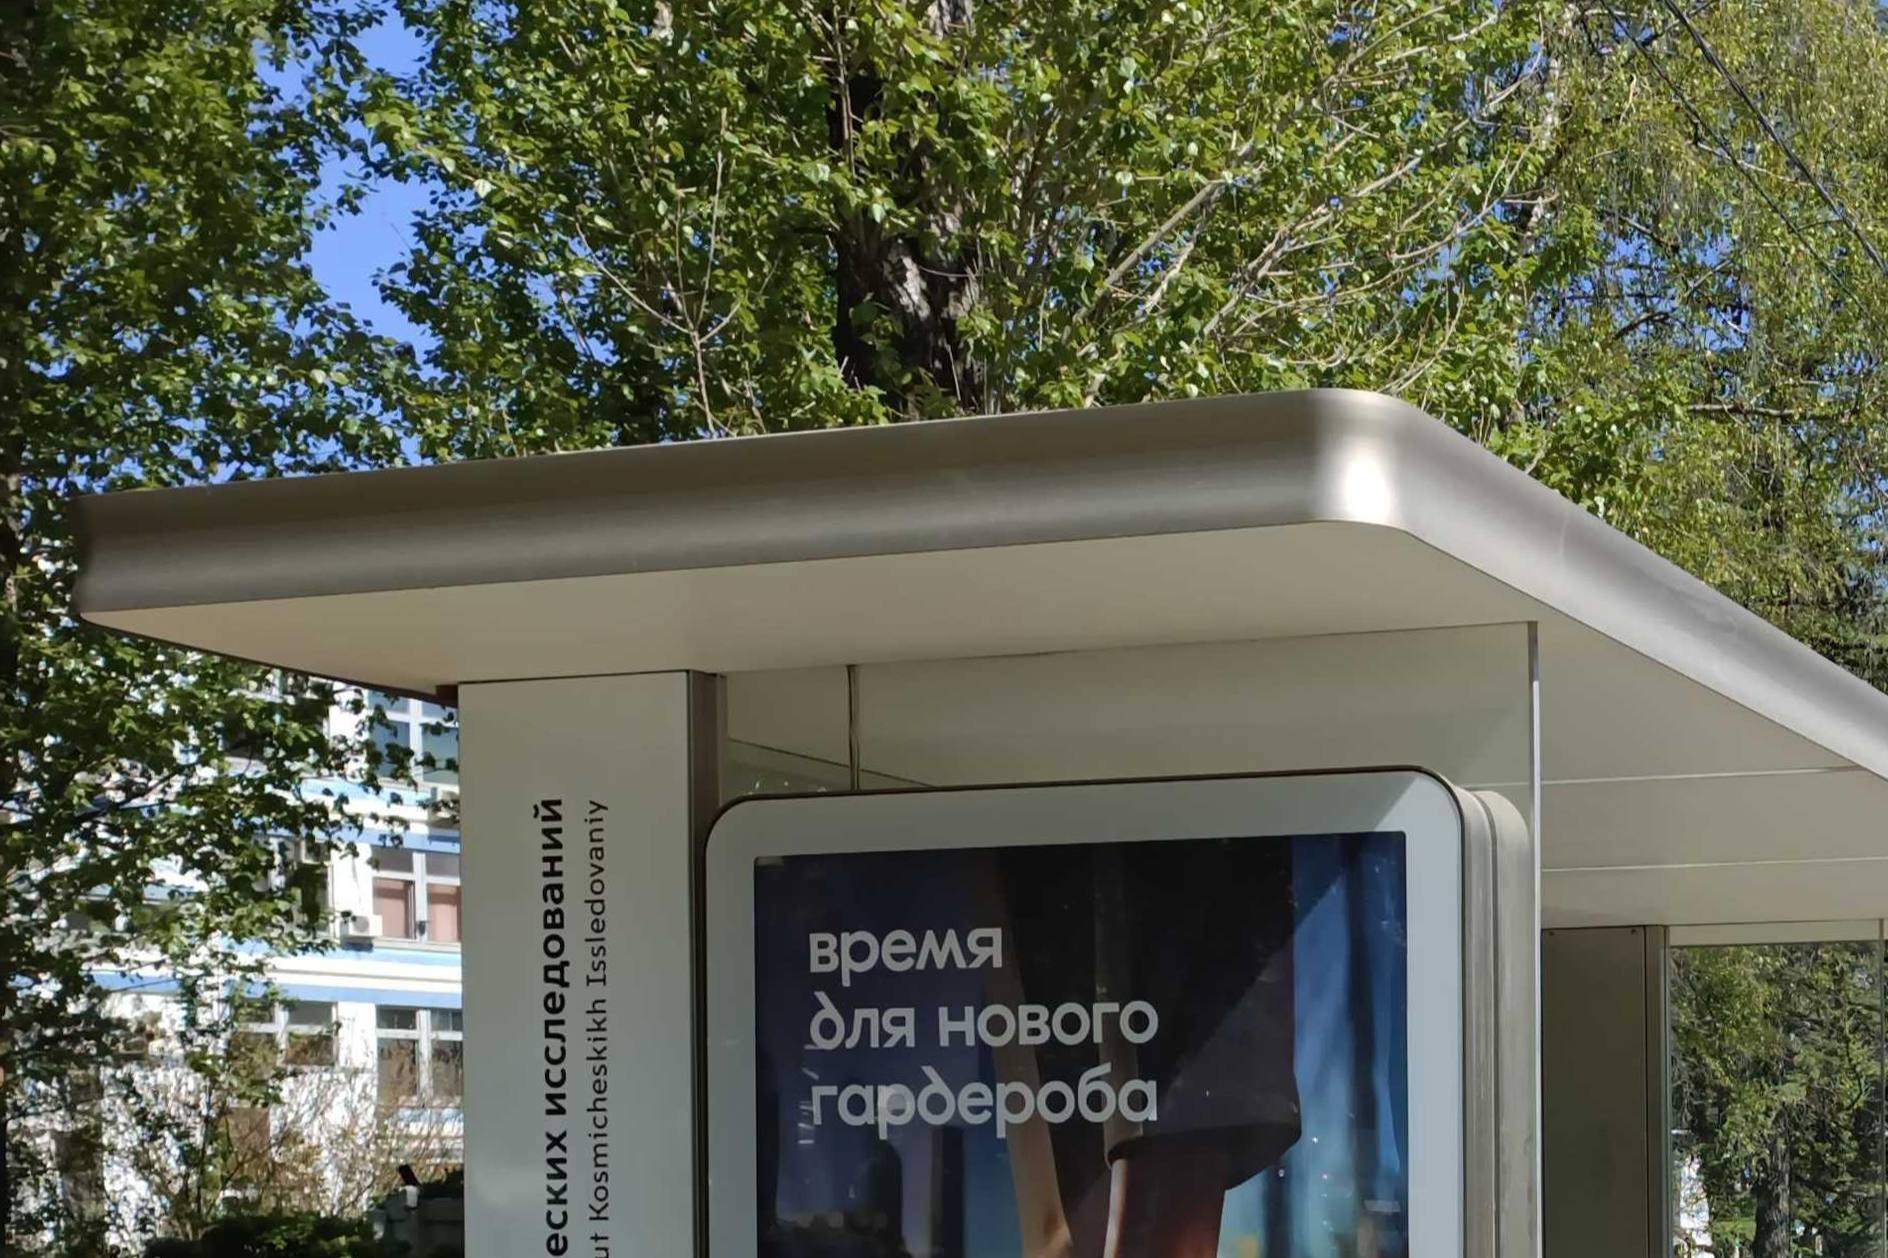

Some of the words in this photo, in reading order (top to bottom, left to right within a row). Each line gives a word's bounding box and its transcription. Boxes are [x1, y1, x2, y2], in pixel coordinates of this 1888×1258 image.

[533, 798, 569, 1116] исследований
[584, 799, 609, 987] Issledovaniy
[808, 925, 1004, 987] время
[808, 991, 918, 1051] для
[938, 997, 1160, 1049] нового
[586, 998, 609, 1221] Kosmicheskikh
[810, 1061, 1159, 1139] гардероба
